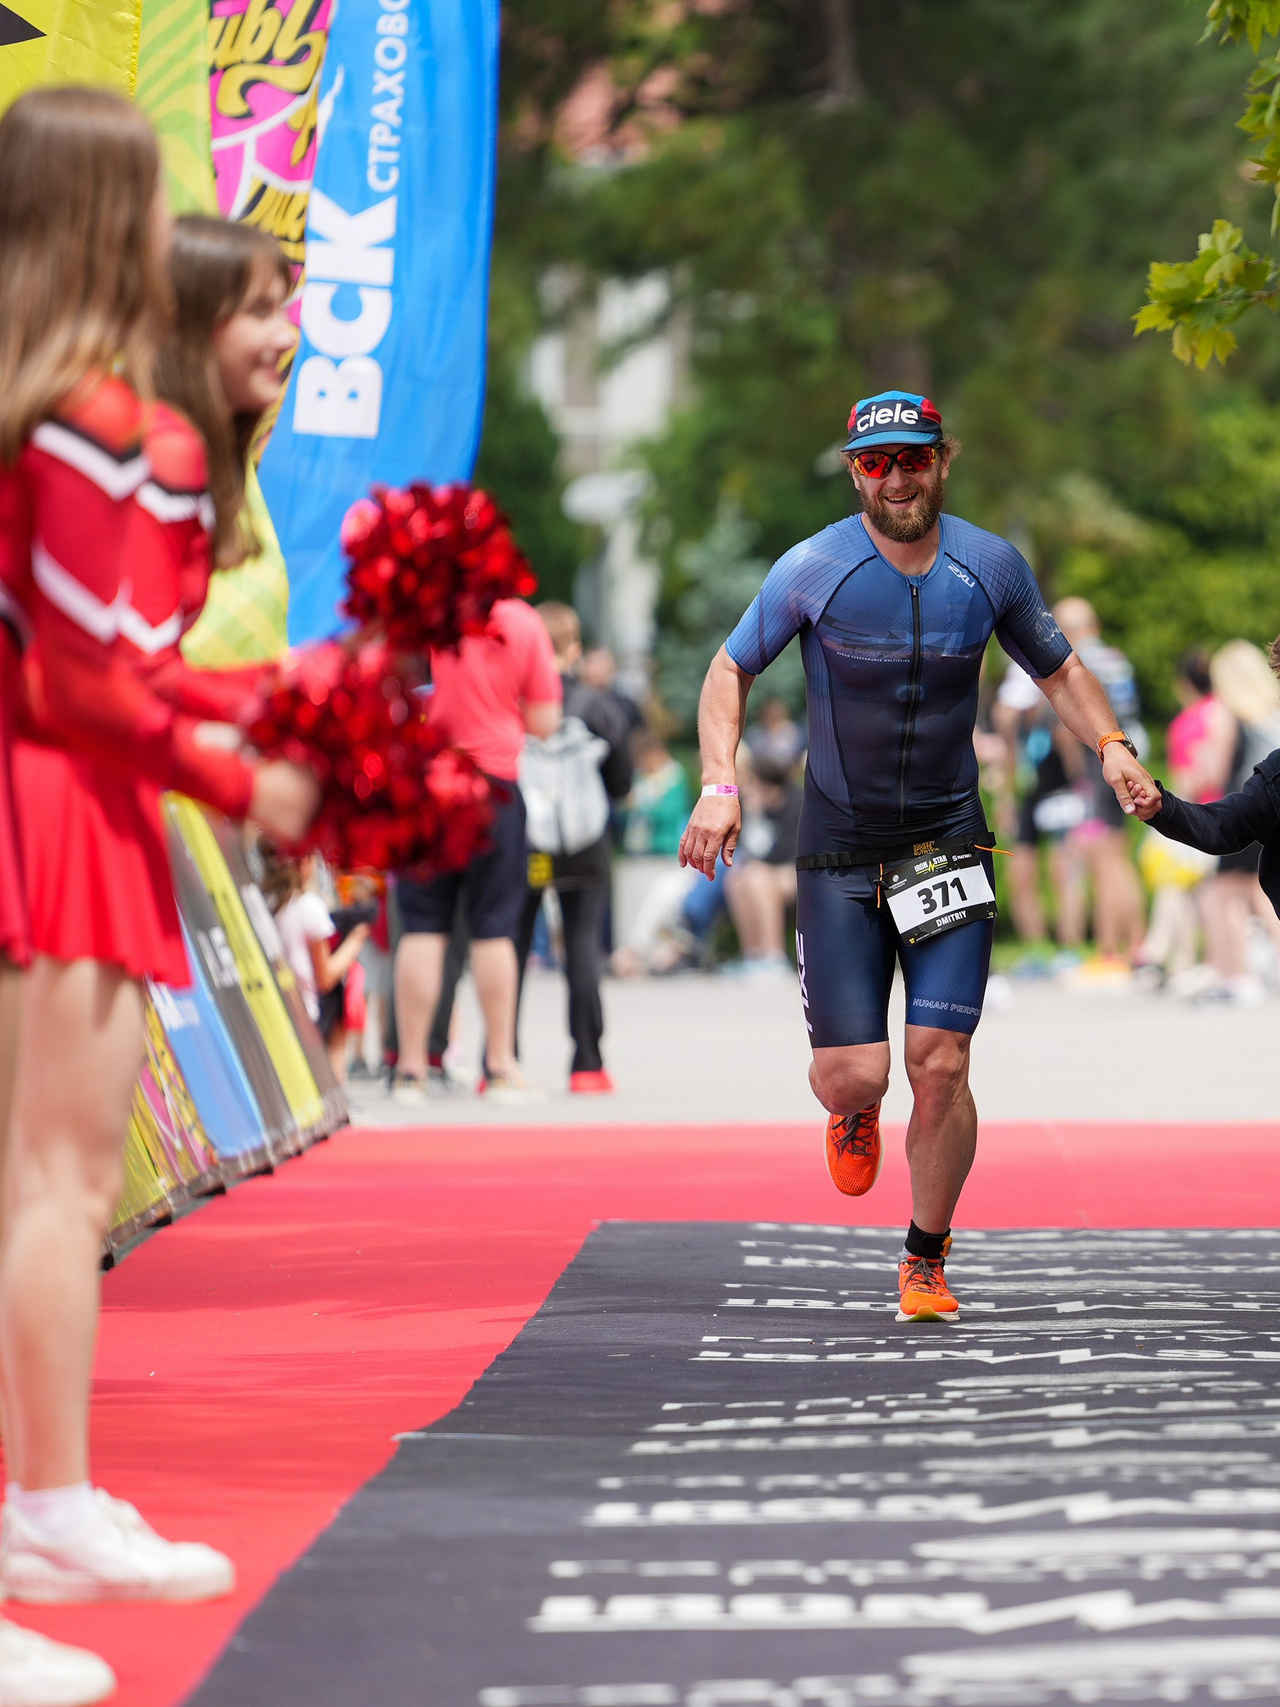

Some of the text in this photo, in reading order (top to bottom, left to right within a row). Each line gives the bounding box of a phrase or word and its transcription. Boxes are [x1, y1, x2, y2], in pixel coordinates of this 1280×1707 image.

[292, 187, 398, 440] ВСК
[856, 402, 919, 433] ciele
[947, 563, 975, 588] 2XU
[914, 861, 929, 873] IRON
[932, 855, 948, 865] STAR
[917, 877, 968, 915] 371
[935, 910, 968, 928] DMITRIY
[912, 998, 949, 1011] HUMAN
